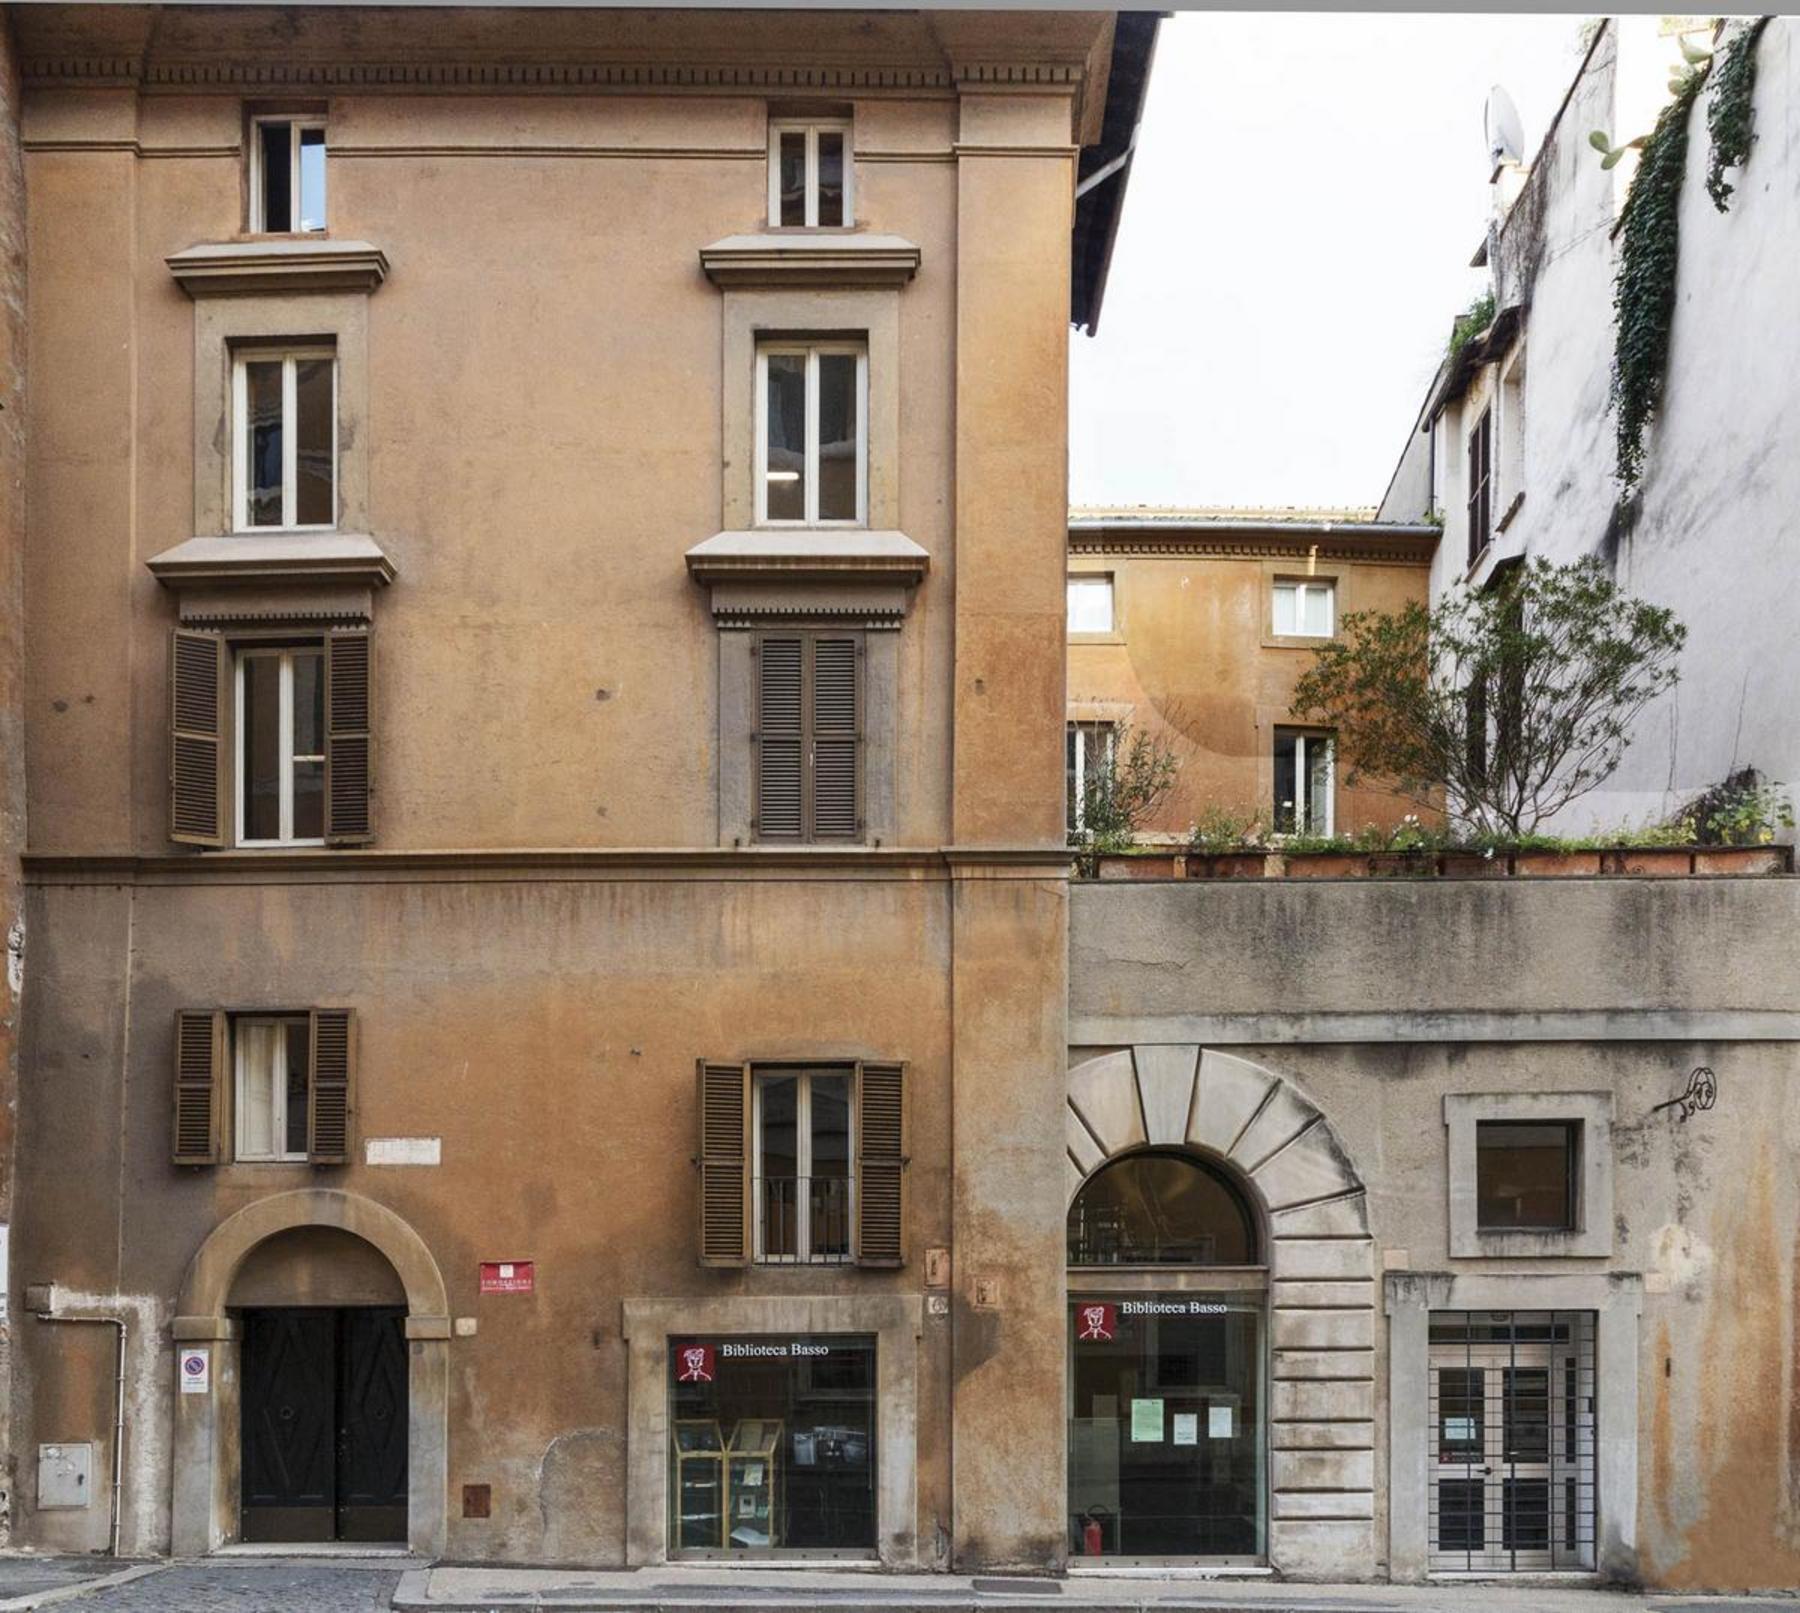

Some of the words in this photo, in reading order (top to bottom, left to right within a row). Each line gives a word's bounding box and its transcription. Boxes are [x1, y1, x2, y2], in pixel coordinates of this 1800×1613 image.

[1122, 1302, 1186, 1314] Biblioteca
[1190, 1301, 1228, 1314] Basso
[722, 1344, 787, 1357] Biblioteca
[791, 1343, 829, 1356] Basso
